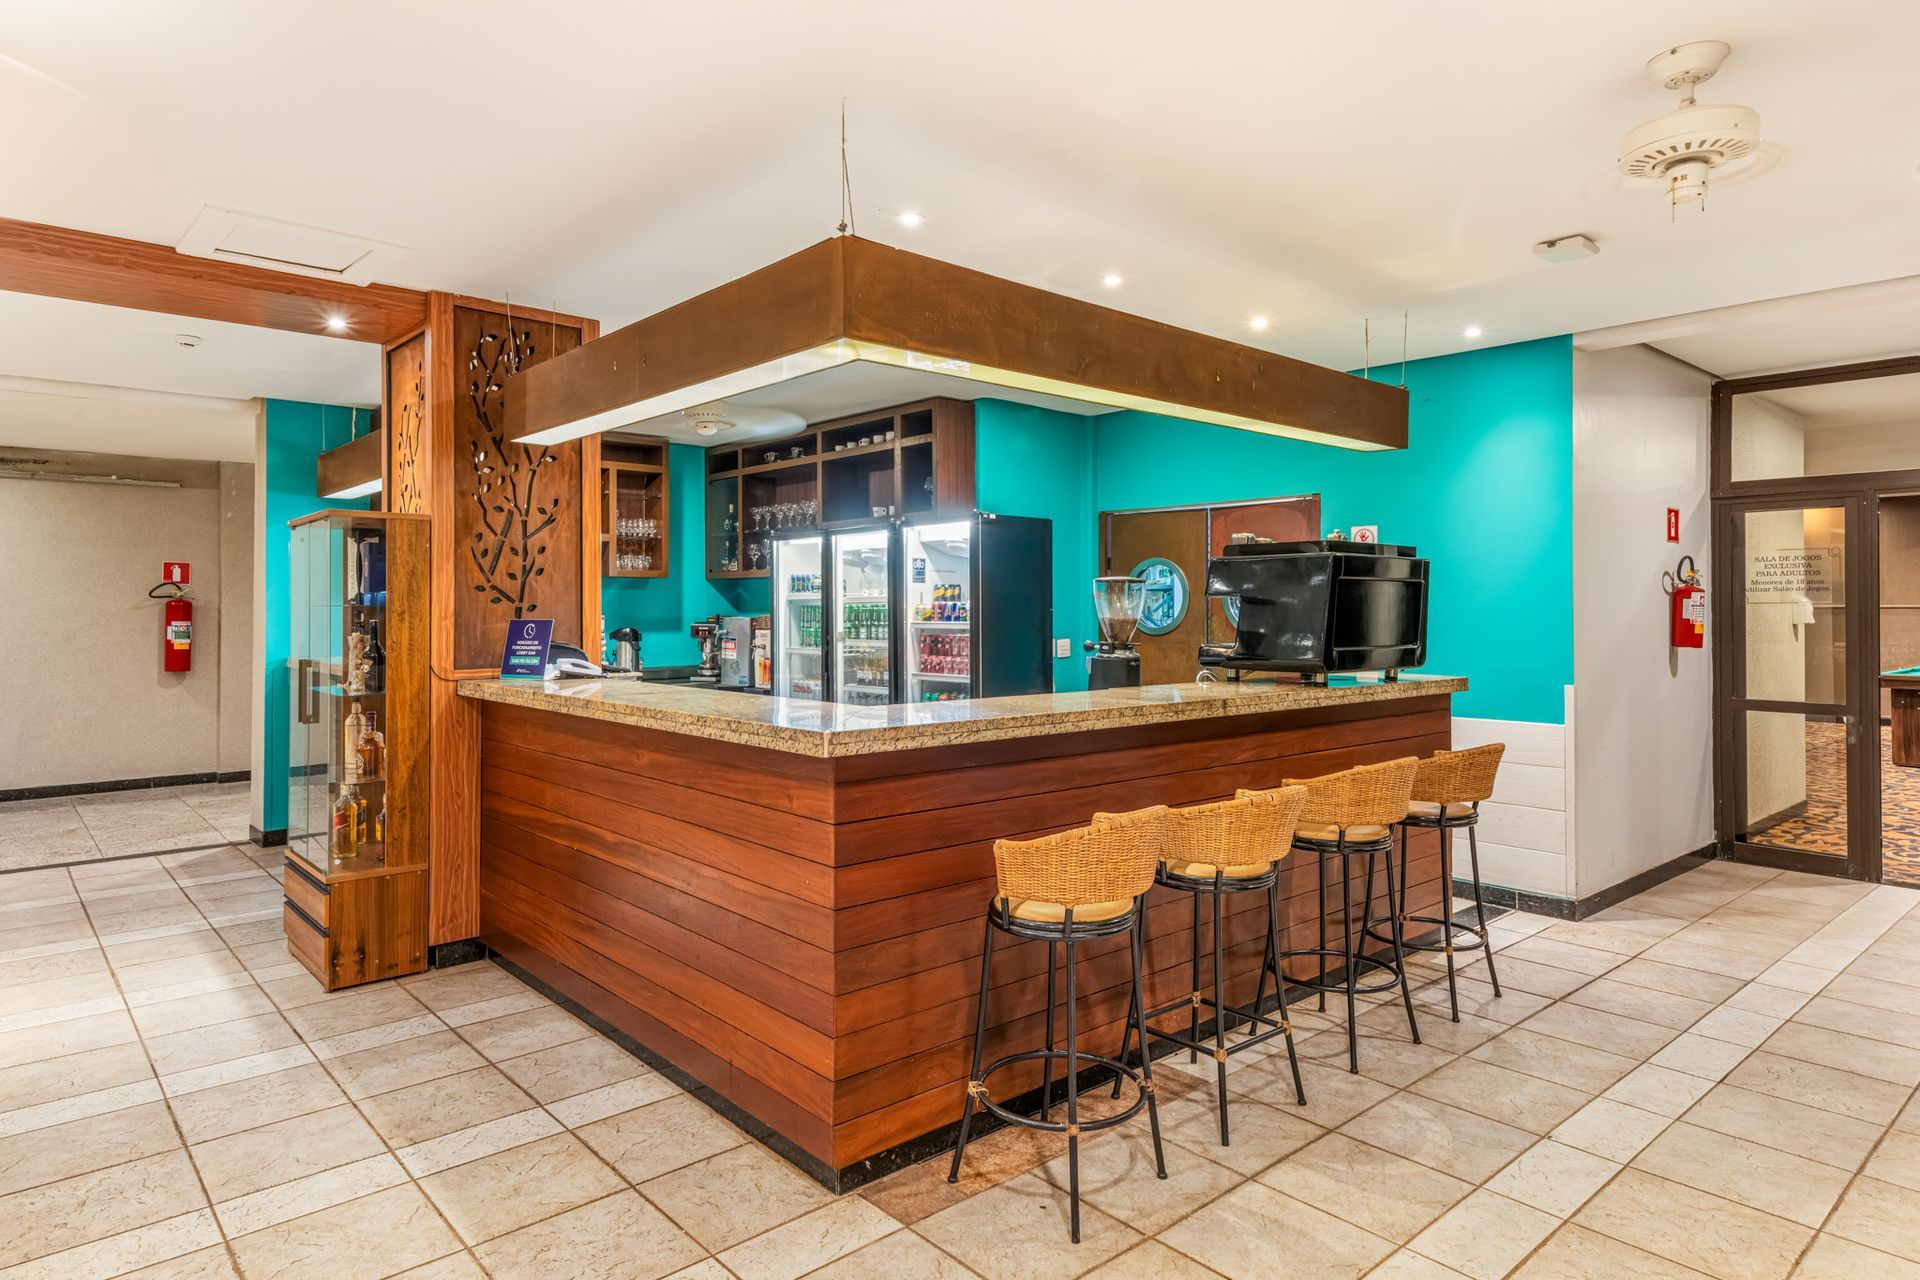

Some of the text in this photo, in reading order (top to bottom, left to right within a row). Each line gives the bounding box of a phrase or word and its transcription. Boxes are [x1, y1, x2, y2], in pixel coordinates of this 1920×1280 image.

[1792, 554, 1822, 562] JOGOS
[1764, 562, 1812, 570] EXCLUSIVA
[1780, 569, 1822, 577] ADULTOS
[1773, 585, 1794, 593] Salão
